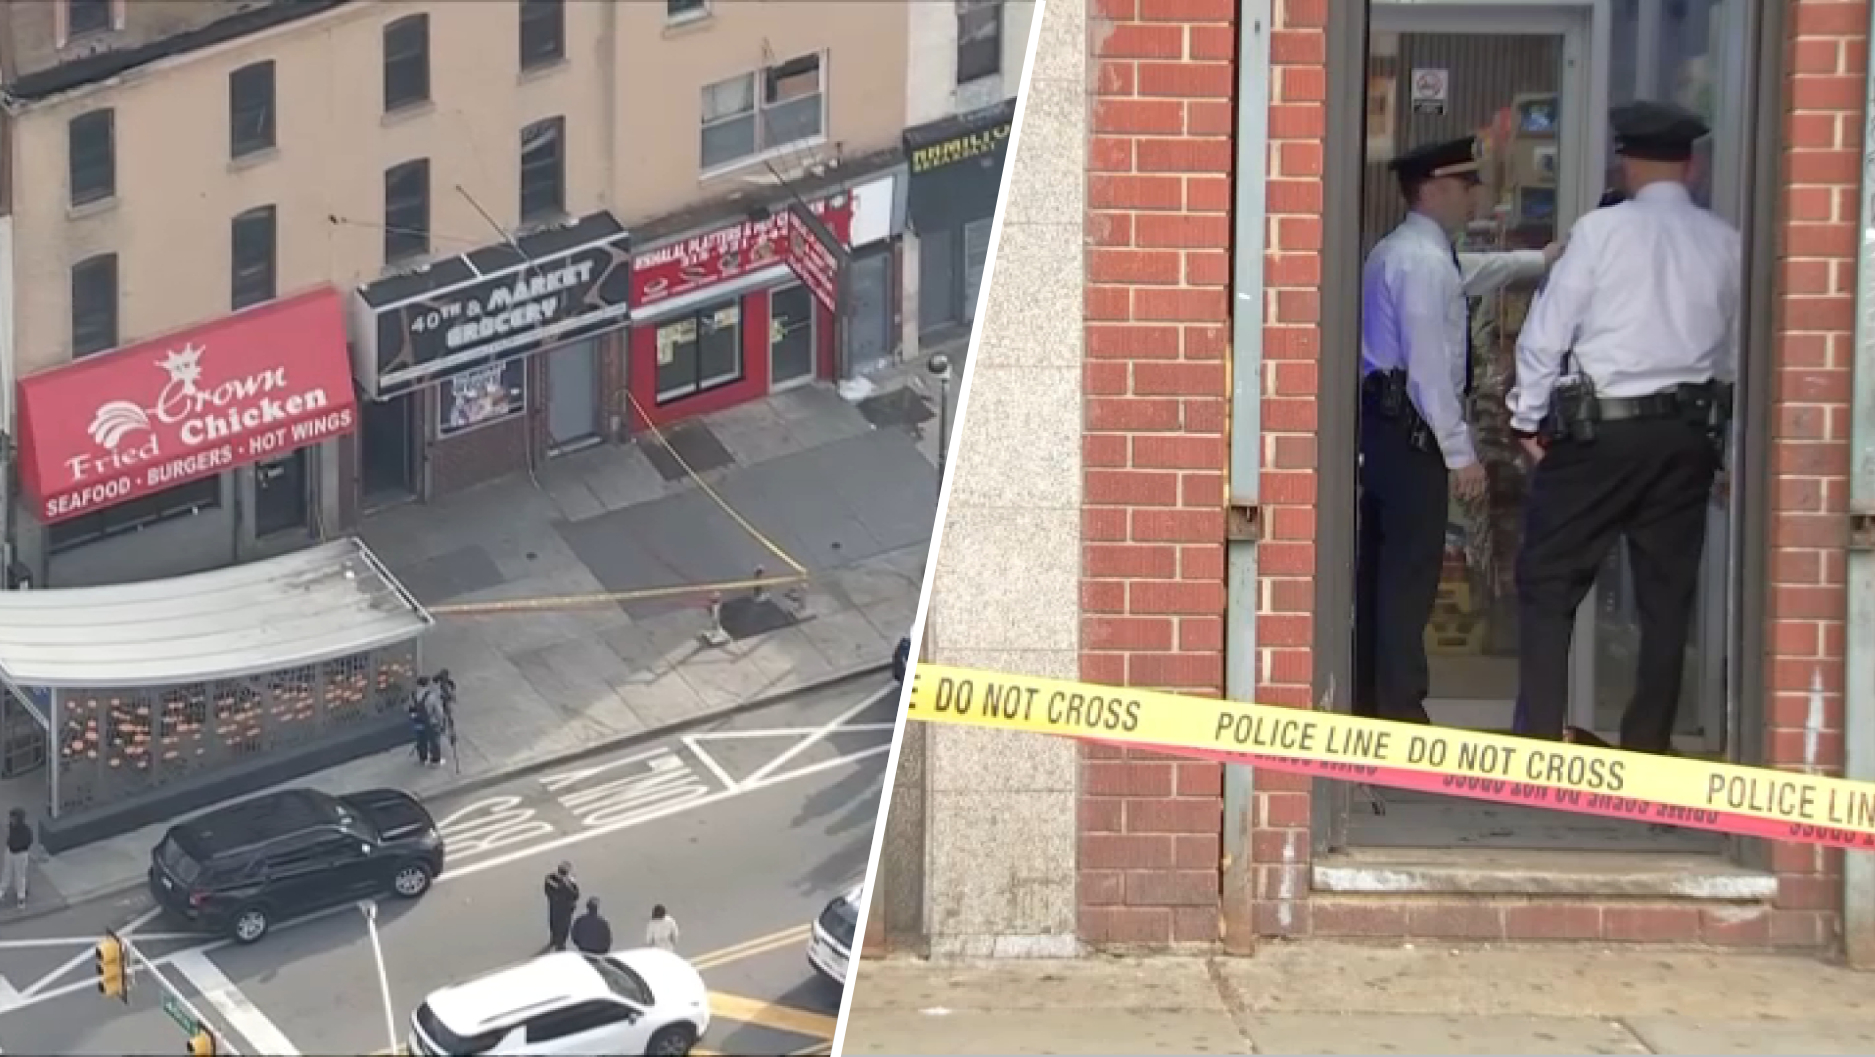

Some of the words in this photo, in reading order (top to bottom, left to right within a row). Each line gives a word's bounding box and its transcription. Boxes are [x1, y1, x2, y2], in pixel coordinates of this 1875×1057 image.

[488, 260, 595, 312] MARKET
[446, 297, 558, 348] GROCERY
[156, 365, 287, 424] Crown
[46, 477, 131, 518] SEAFOOD
[147, 445, 232, 485] BURGERS
[249, 429, 287, 455] HOT
[291, 409, 352, 442] WINGS
[65, 434, 159, 482] Fried
[181, 388, 326, 445] Chicken
[934, 677, 973, 714] DO
[982, 683, 1039, 721] NOT
[1048, 691, 1141, 731] CROSS
[1214, 711, 1317, 751] POLICE
[1325, 726, 1391, 759] LINE
[1407, 736, 1447, 767] DO
[1458, 742, 1516, 776] NOT
[1526, 750, 1625, 791] CROSS
[538, 747, 709, 825] ONLY
[1706, 772, 1816, 819] POLICE
[1828, 788, 1875, 828] LIN
